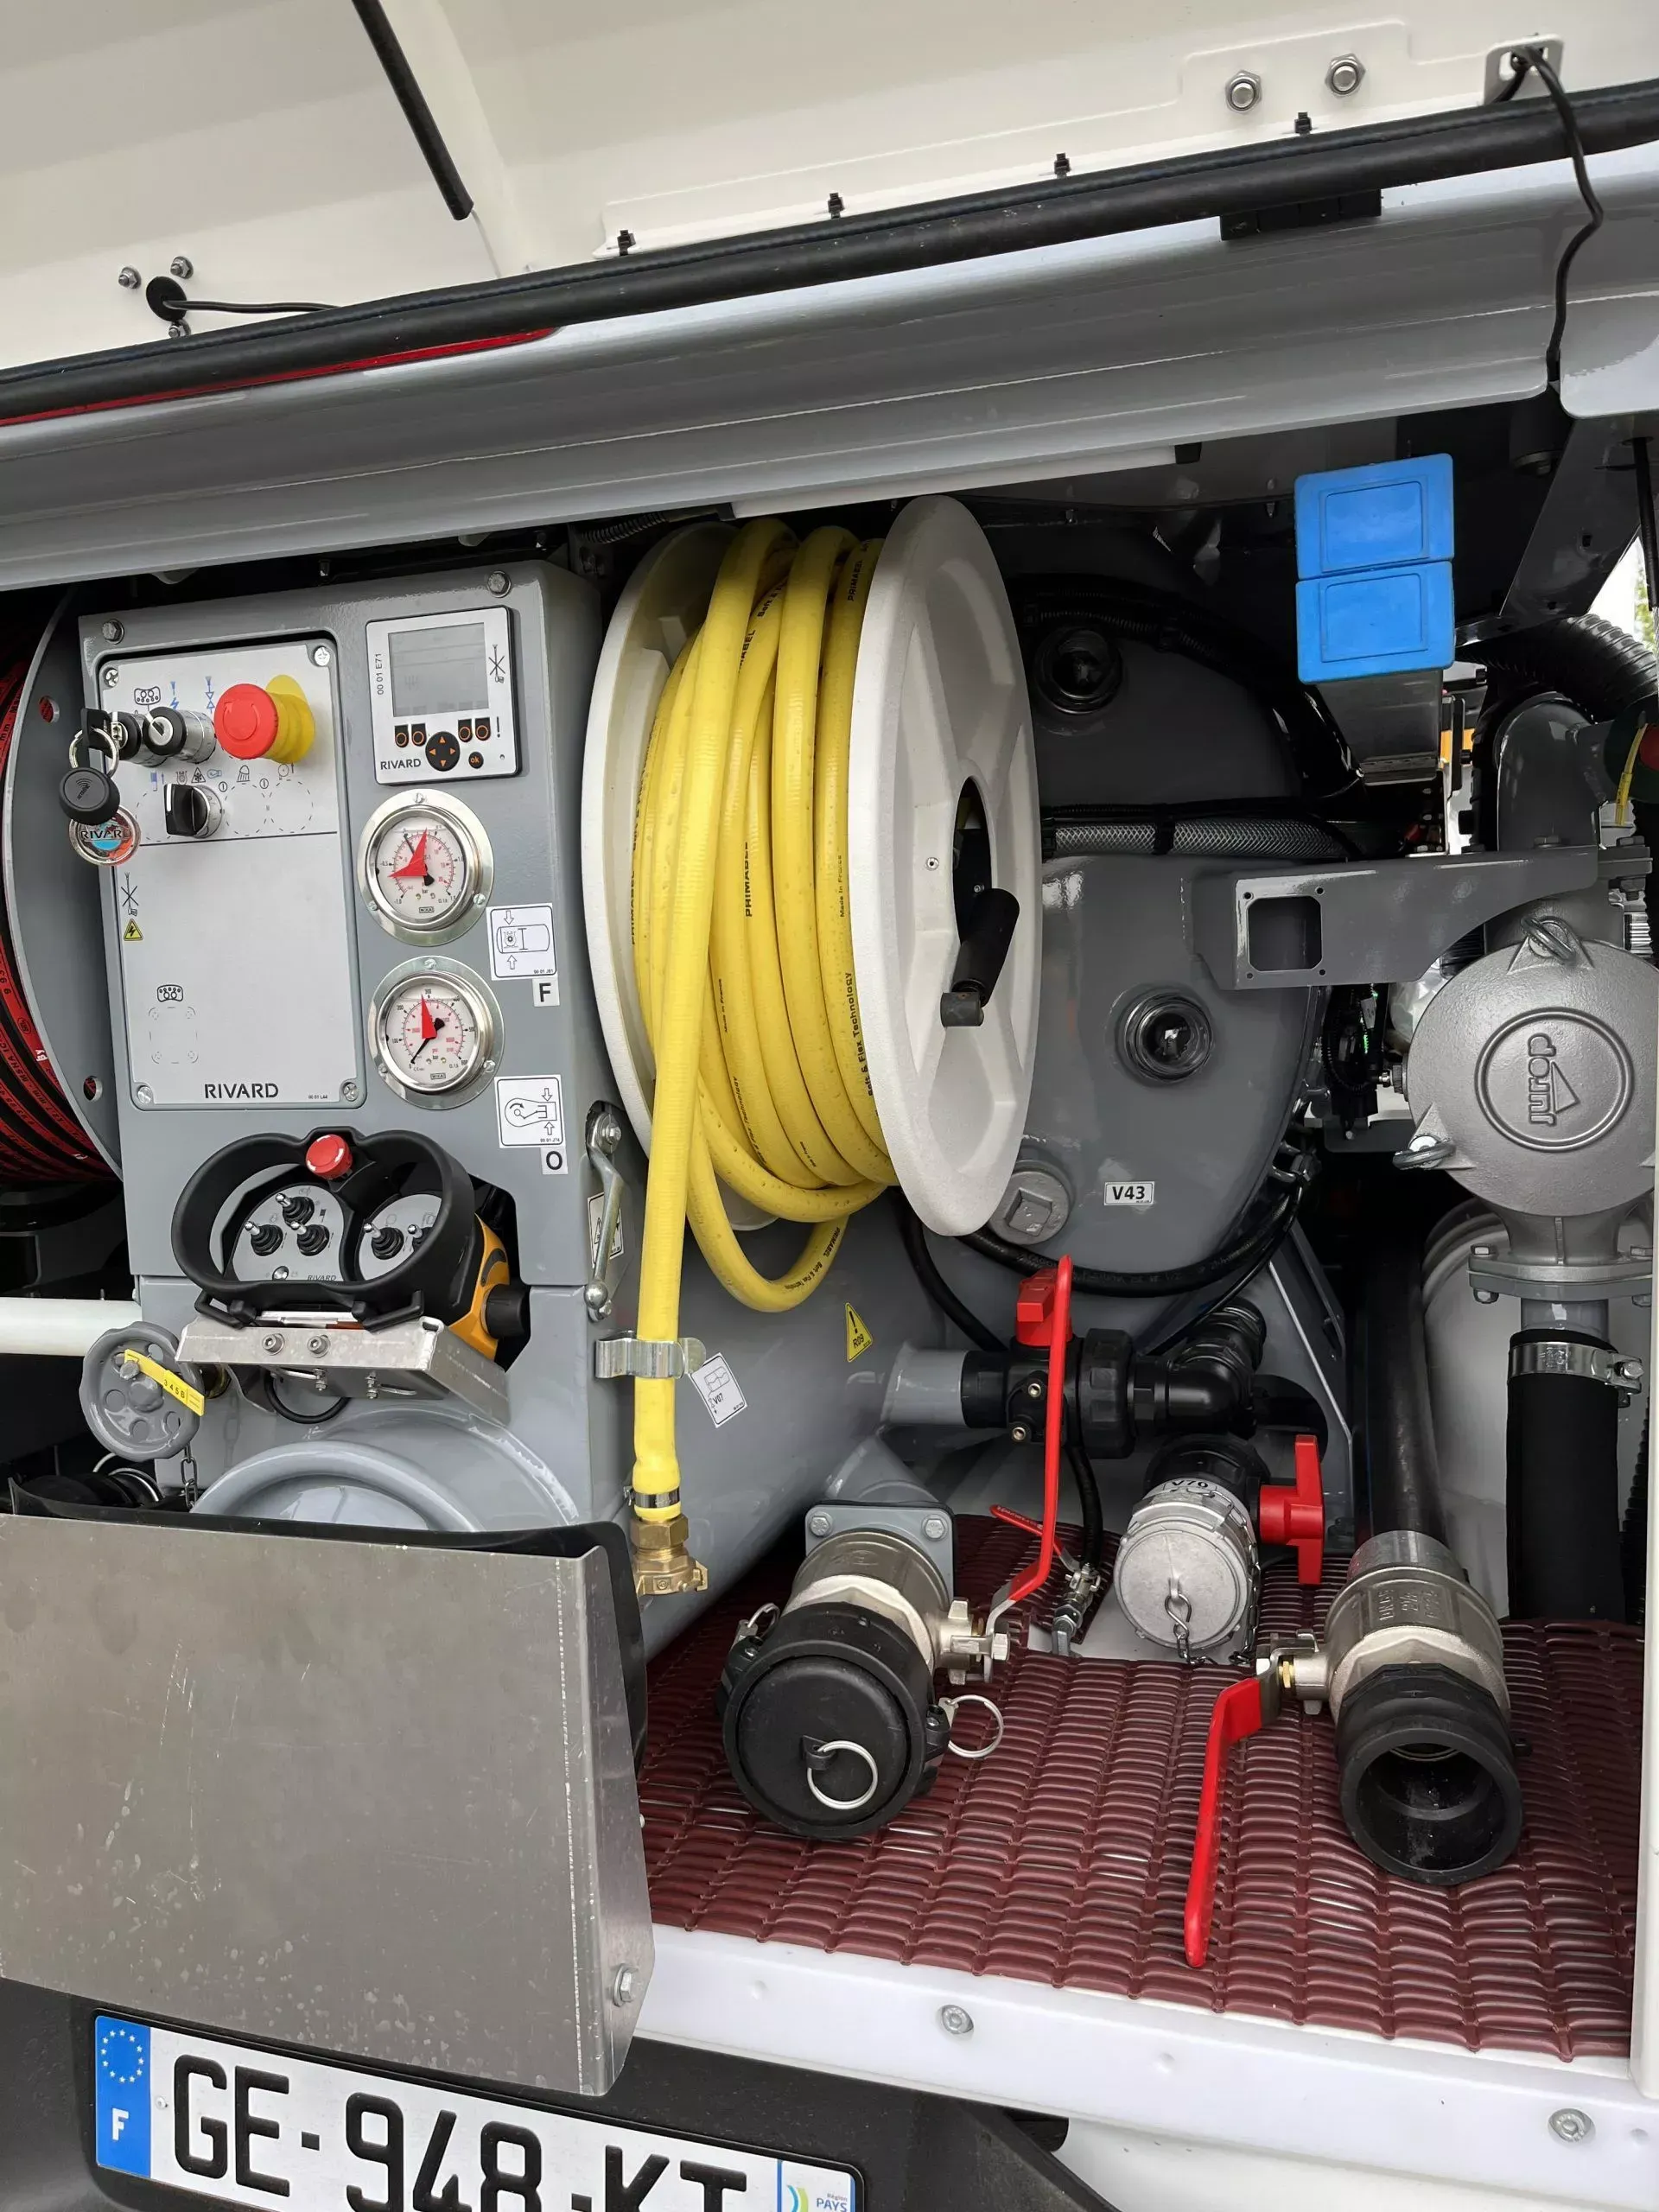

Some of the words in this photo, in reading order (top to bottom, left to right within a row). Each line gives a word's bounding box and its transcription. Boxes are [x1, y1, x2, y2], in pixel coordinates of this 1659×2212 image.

[377, 672, 383, 683] 01
[378, 684, 384, 695] 00
[380, 759, 422, 771] RIVARD
[81, 830, 131, 841] RIVARD
[539, 982, 551, 1002] F
[846, 972, 860, 1038] Technology
[35, 1050, 48, 1062] By
[7, 1056, 29, 1082] MSHA
[204, 1083, 279, 1099] RIVARD
[1112, 1185, 1145, 1200] V43
[823, 1227, 841, 1257] PRIMABEL
[853, 1333, 864, 1349] R09
[713, 1392, 724, 1405] V07
[112, 2107, 129, 2141] F
[816, 2197, 848, 2212] PAYS
